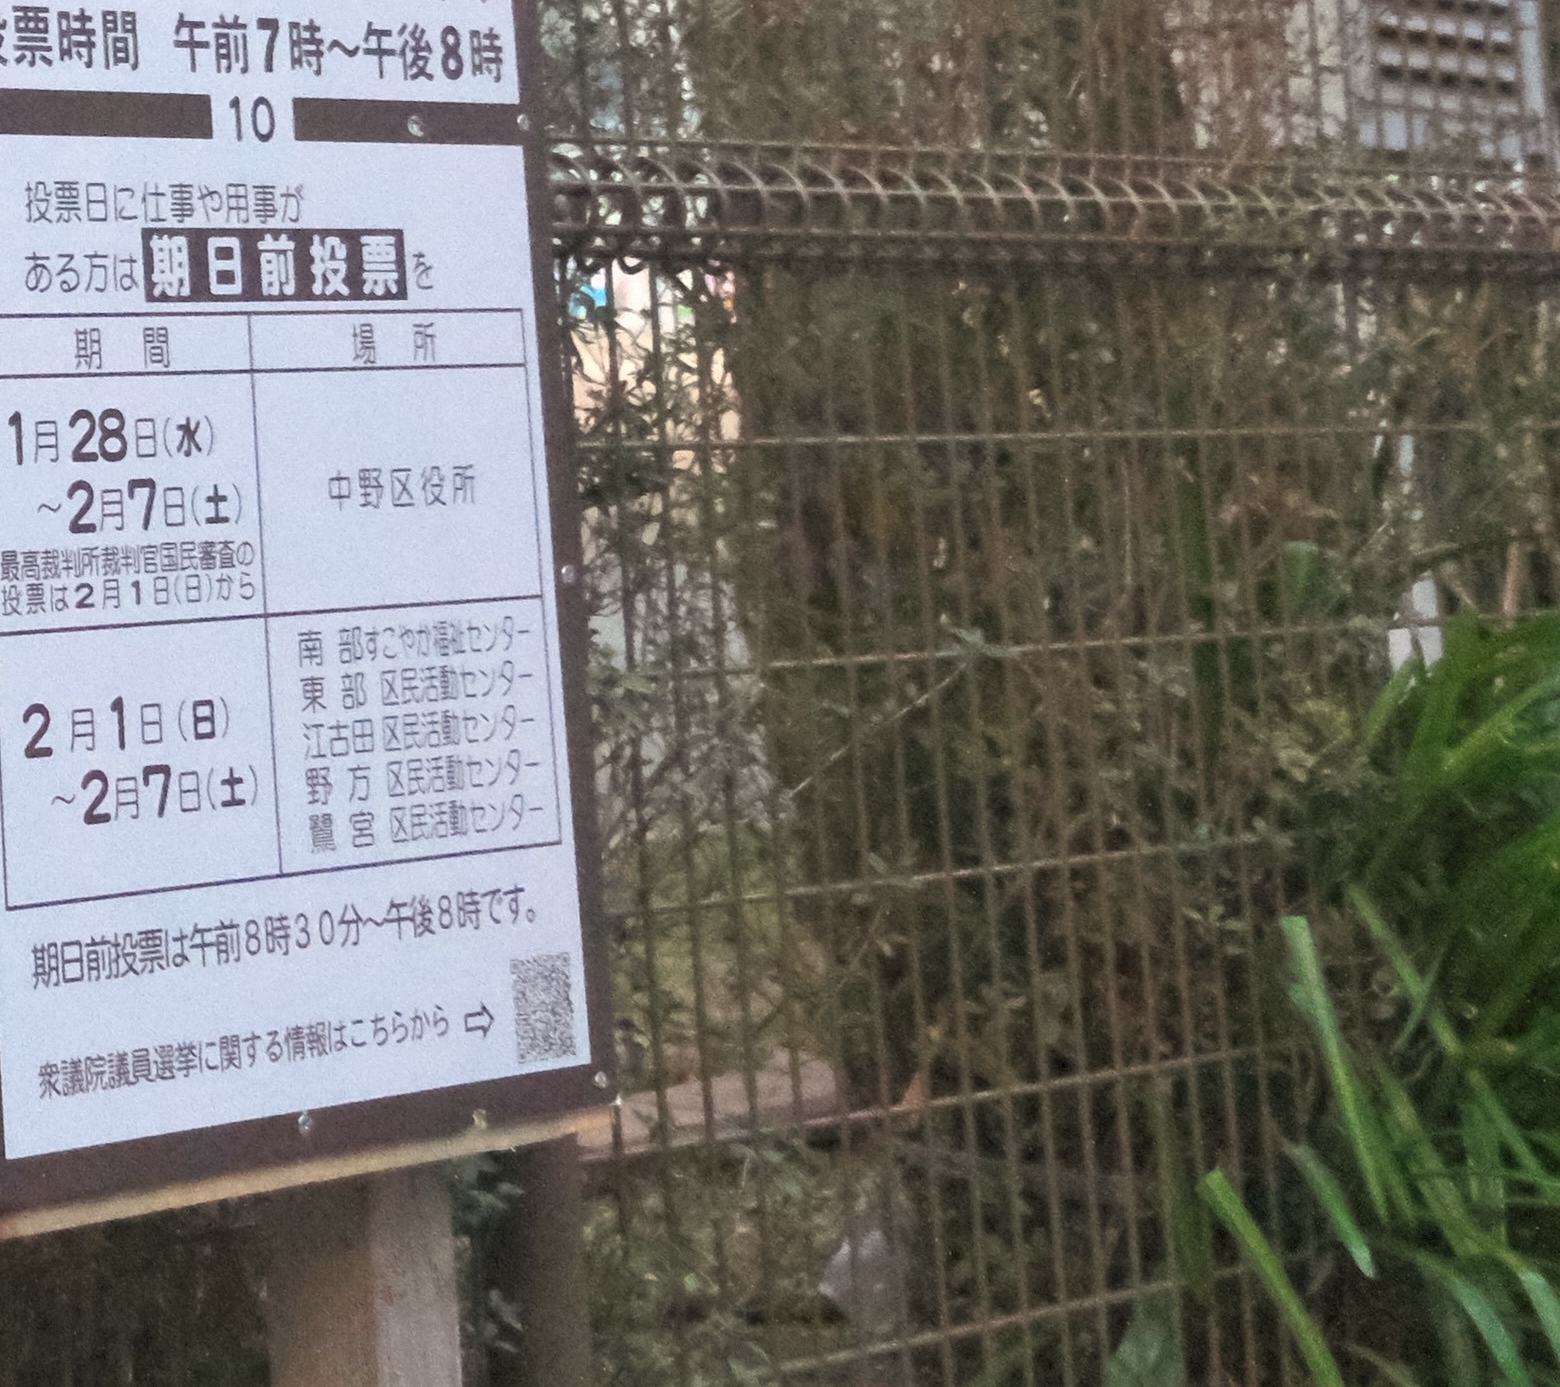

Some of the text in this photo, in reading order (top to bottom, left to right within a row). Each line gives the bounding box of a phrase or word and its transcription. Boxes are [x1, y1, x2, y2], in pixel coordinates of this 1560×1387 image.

[229, 96, 276, 144] 10
[24, 180, 305, 226] 投票日に仕事や用事が
[328, 463, 478, 512] 中野区役所
[0, 541, 256, 582] 最高裁判所裁判官国民審査の
[37, 1004, 451, 1101] 衆議院議員選挙に関する情報はこちらから
